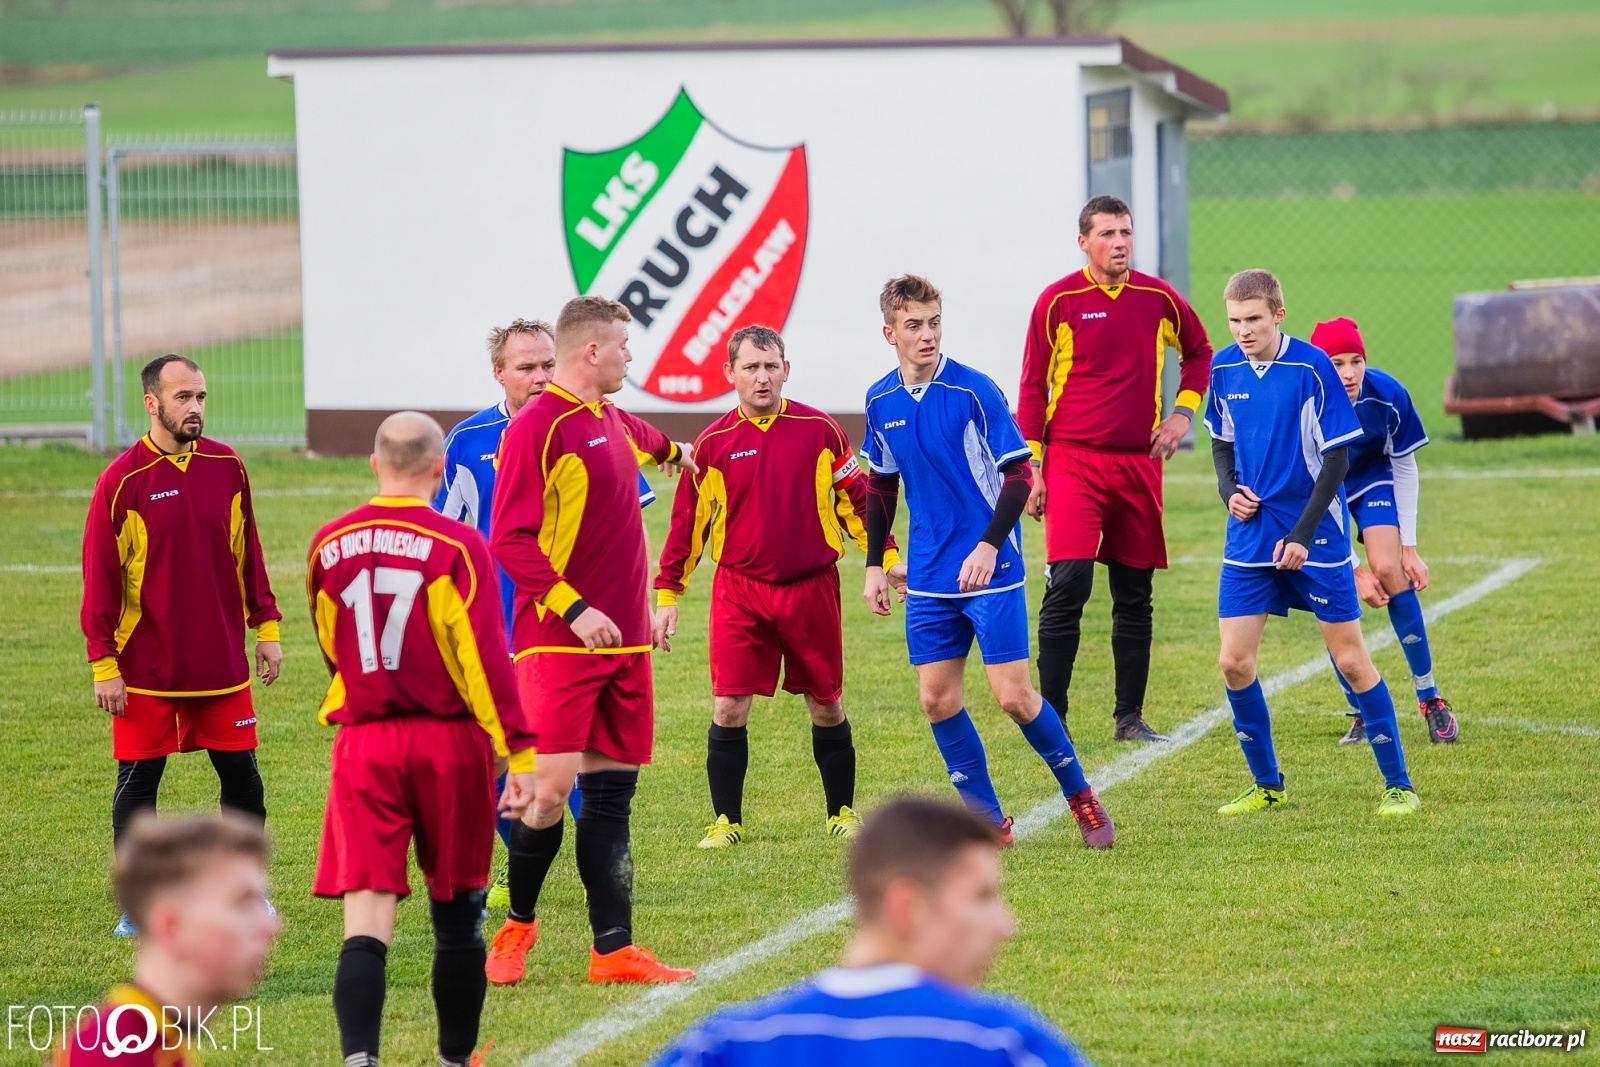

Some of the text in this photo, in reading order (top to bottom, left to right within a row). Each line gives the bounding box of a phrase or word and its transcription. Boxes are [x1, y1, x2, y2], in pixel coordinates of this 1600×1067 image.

[575, 151, 660, 251] LKS
[617, 164, 749, 330] RUCH
[319, 539, 341, 571] LKS
[340, 528, 374, 560] RUCH
[340, 566, 425, 674] 17
